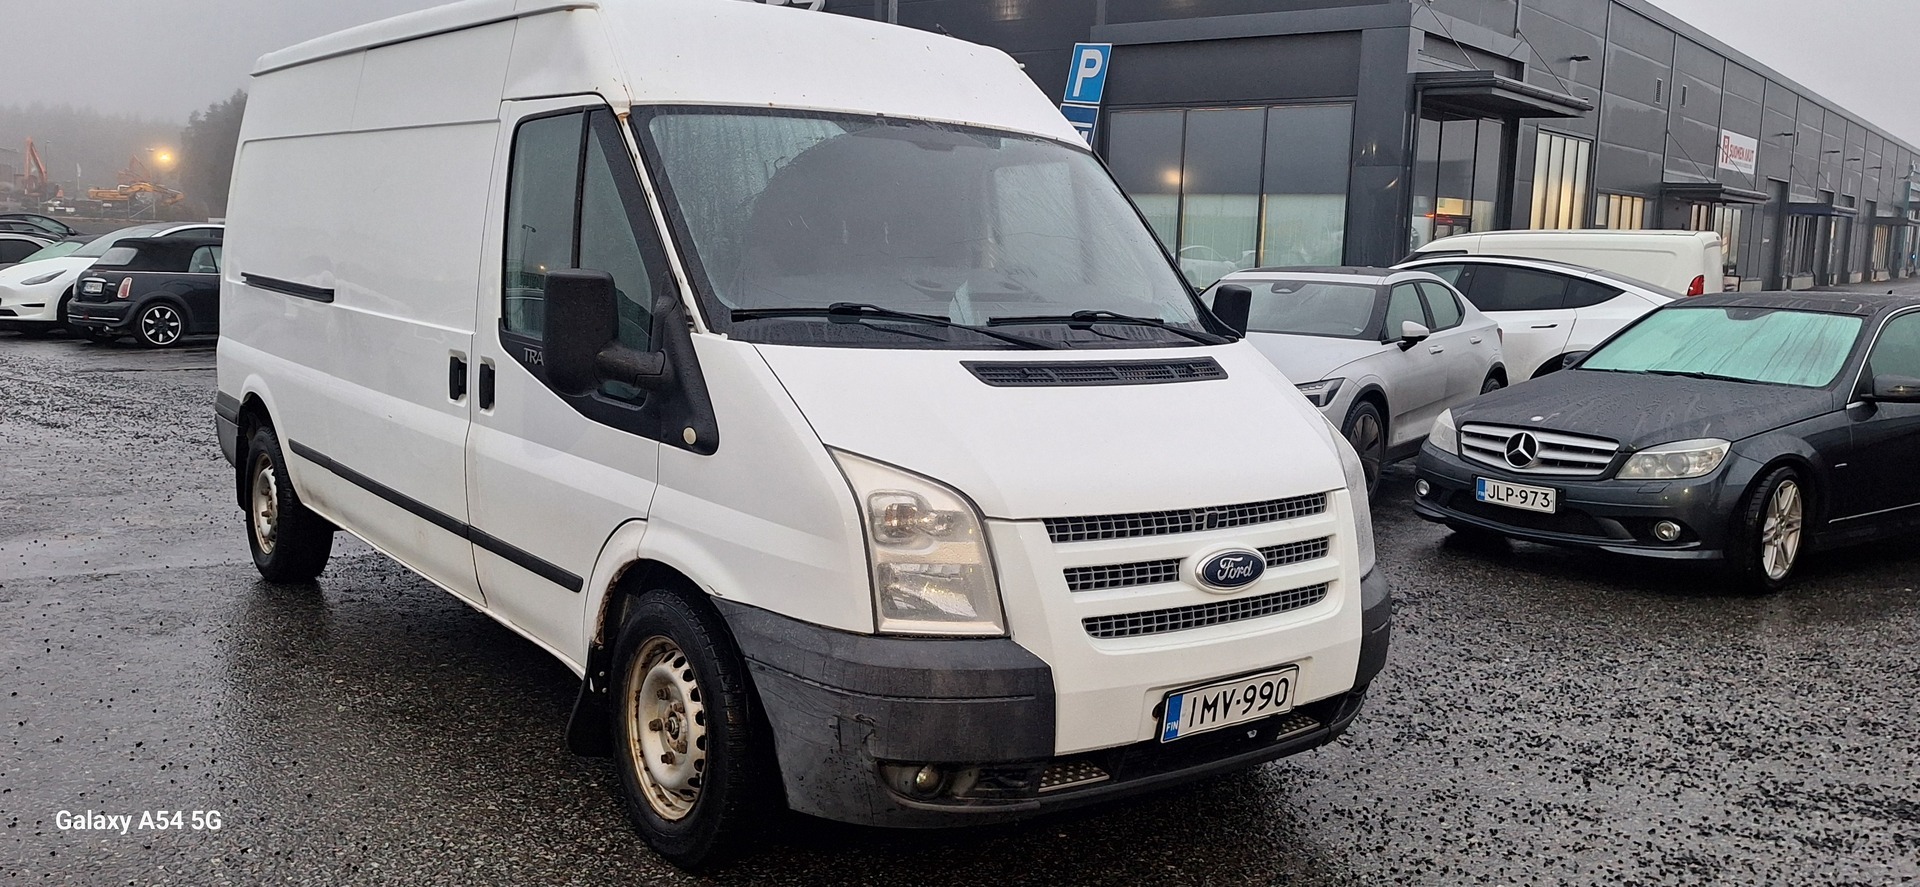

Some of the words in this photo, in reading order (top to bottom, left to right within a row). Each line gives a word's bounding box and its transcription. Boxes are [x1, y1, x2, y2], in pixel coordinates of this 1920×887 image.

[1072, 49, 1103, 97] P
[523, 347, 545, 366] TRA
[1487, 484, 1551, 508] JLP-973
[1217, 556, 1254, 581] Ford
[1166, 719, 1179, 732] FIN
[1188, 677, 1290, 728] IMV-990
